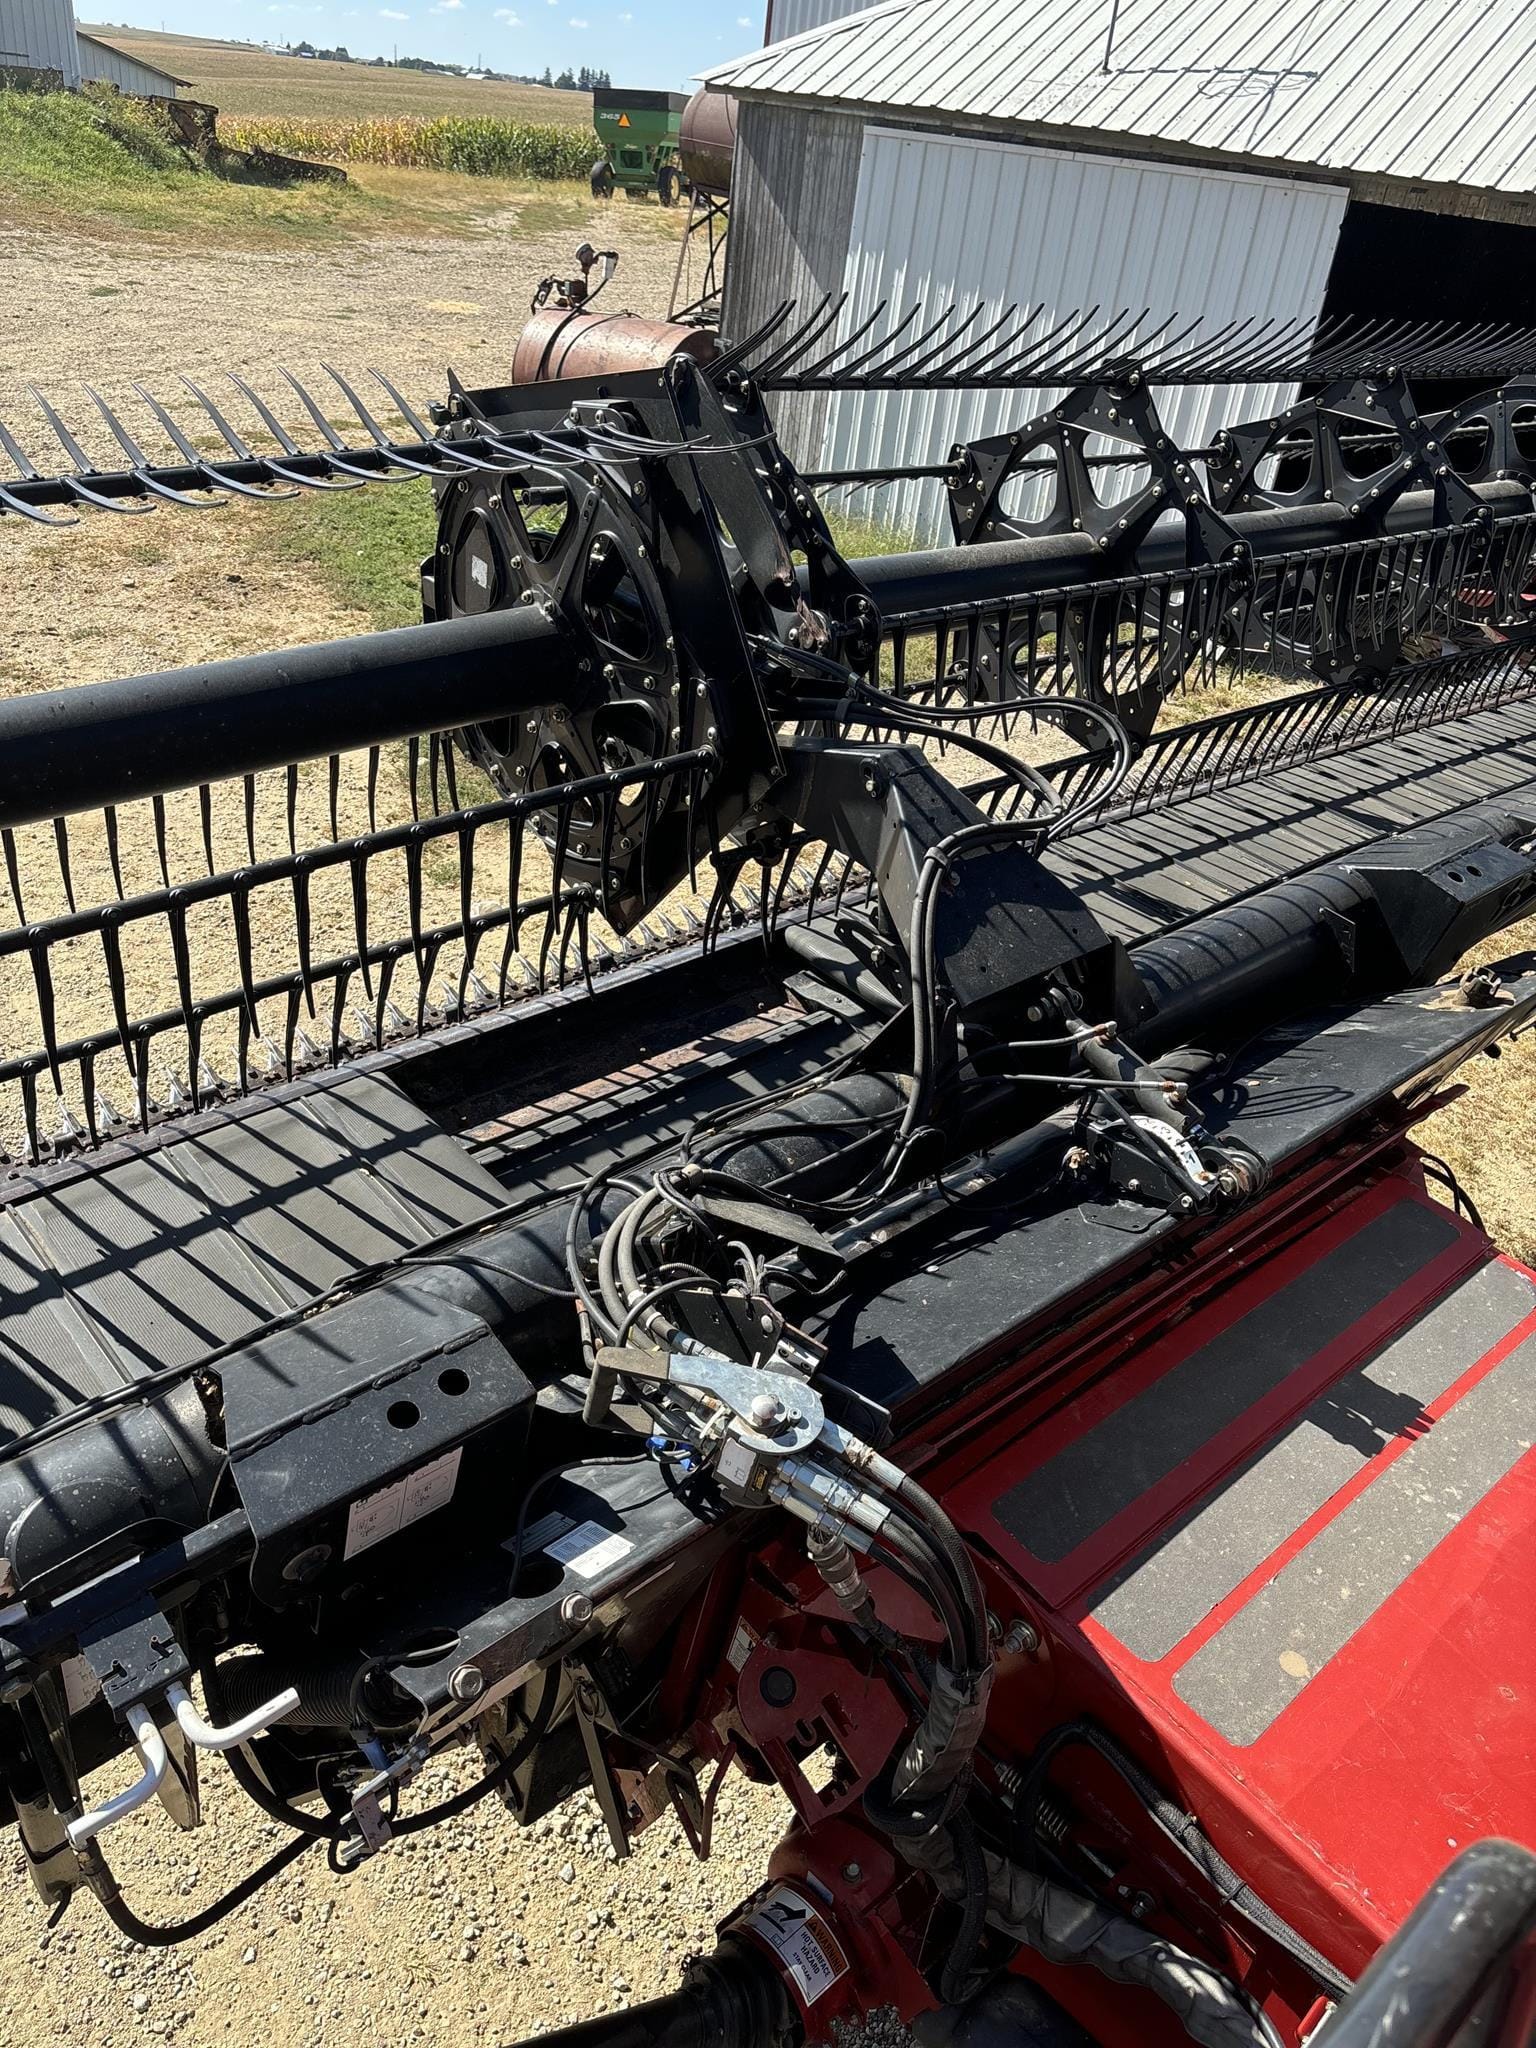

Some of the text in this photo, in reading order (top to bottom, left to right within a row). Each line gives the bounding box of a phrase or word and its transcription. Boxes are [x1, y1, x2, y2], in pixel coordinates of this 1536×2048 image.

[792, 1952, 812, 1981] STAY CLEAR
[800, 1931, 831, 1978] HOT SURFACE
[800, 1944, 820, 1975] HAZARD
[816, 1928, 843, 1972] WARNING
